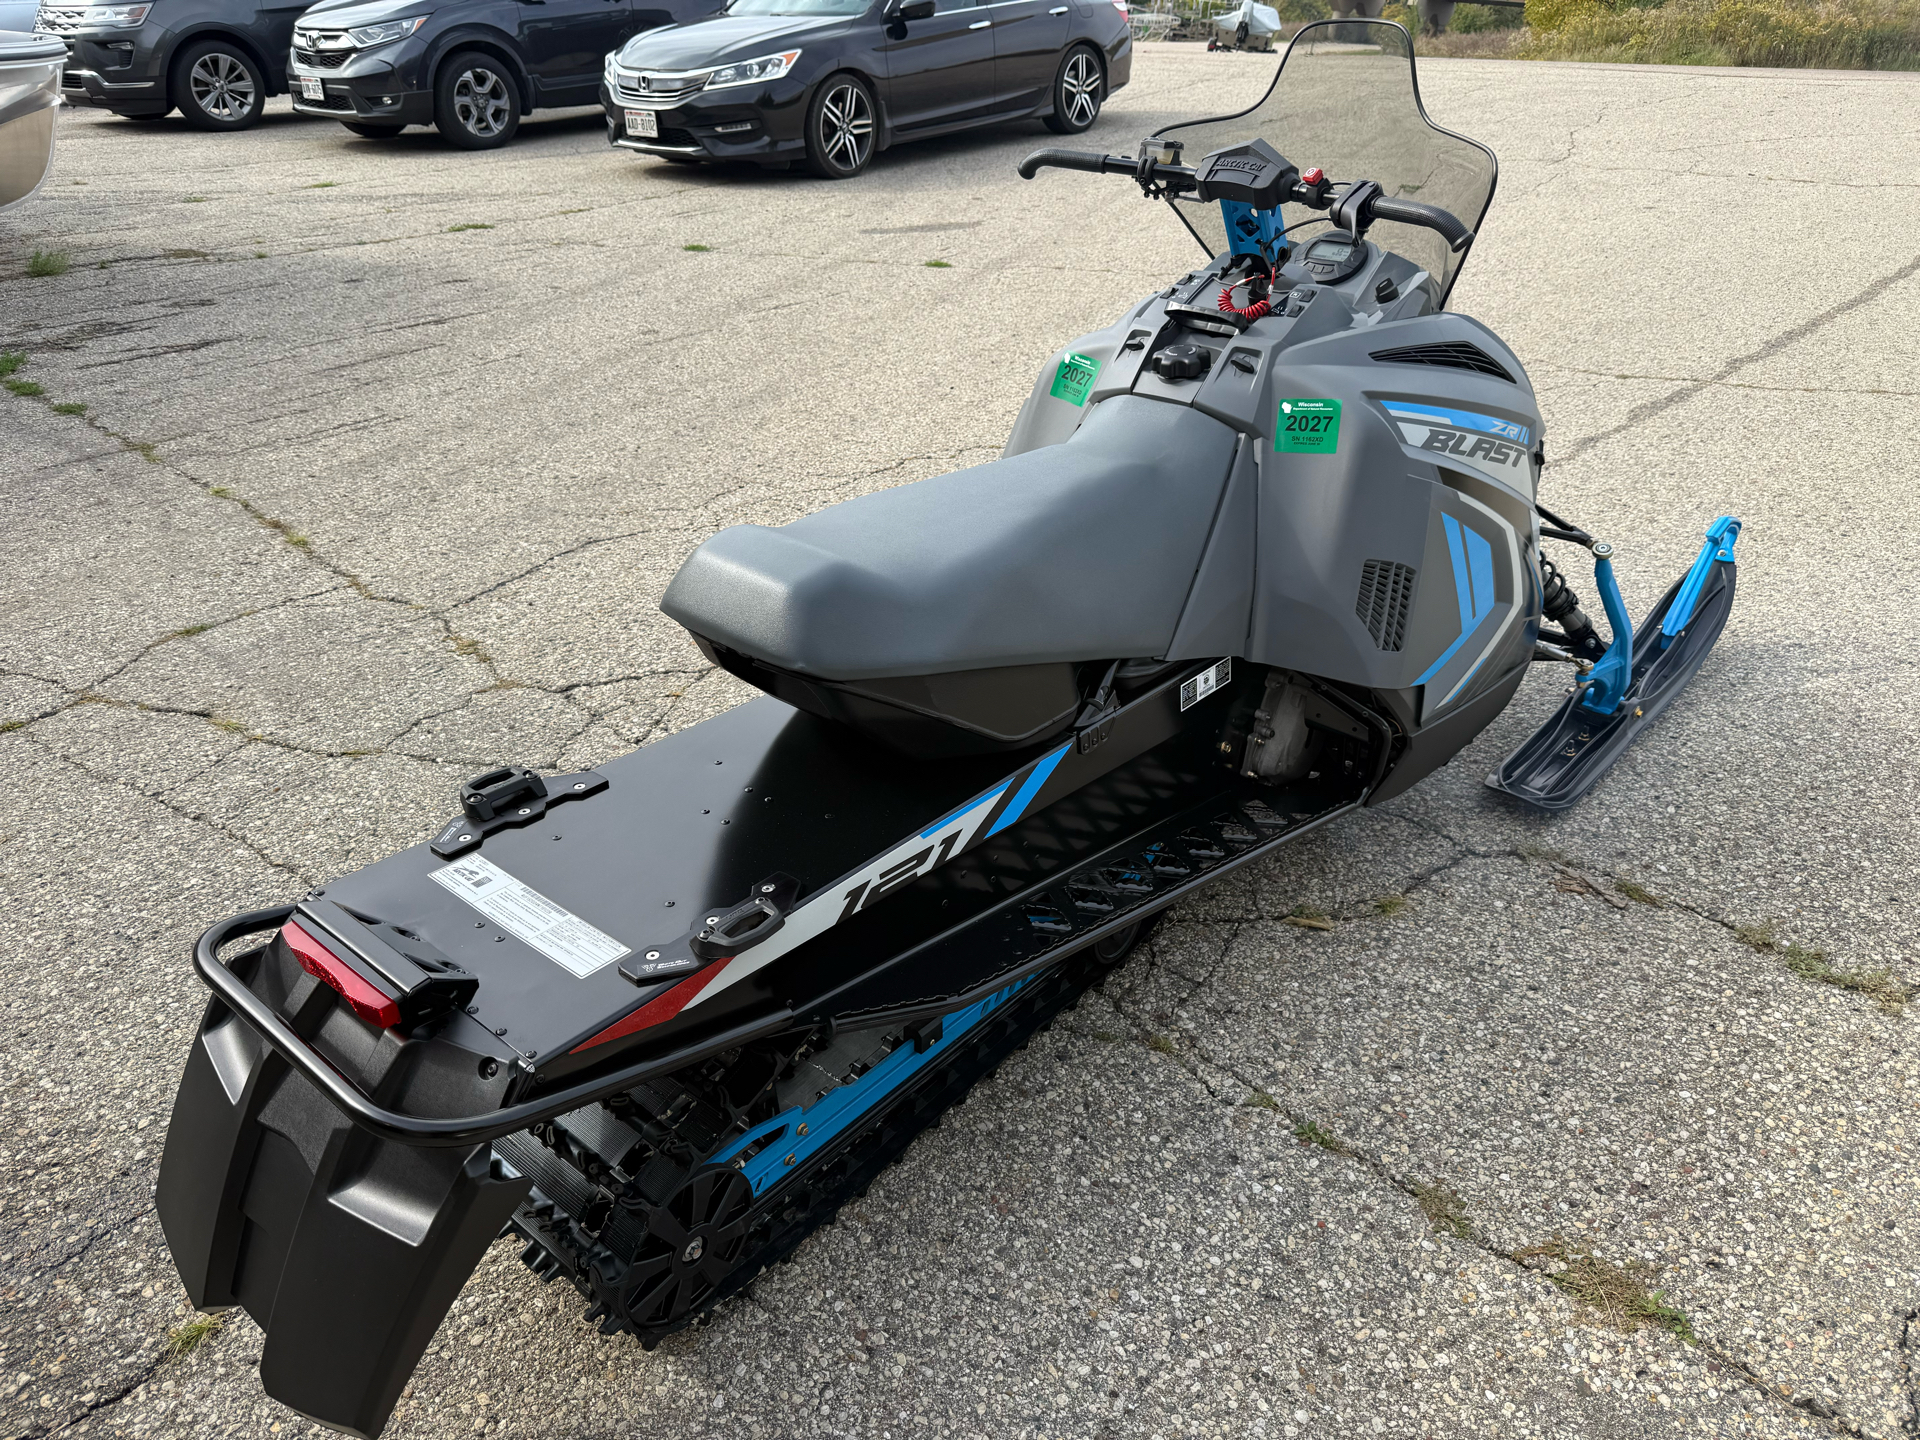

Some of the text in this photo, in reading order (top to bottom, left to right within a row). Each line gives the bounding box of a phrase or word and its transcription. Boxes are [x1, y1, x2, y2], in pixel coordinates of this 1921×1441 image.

[627, 117, 656, 132] AAD-8102
[1216, 158, 1268, 172] ARCTIC CAT
[1061, 365, 1093, 387] 2027
[1285, 415, 1334, 432] 2027
[1490, 420, 1519, 438] ZR
[1420, 428, 1527, 468] BLAST
[834, 828, 964, 926] 121
